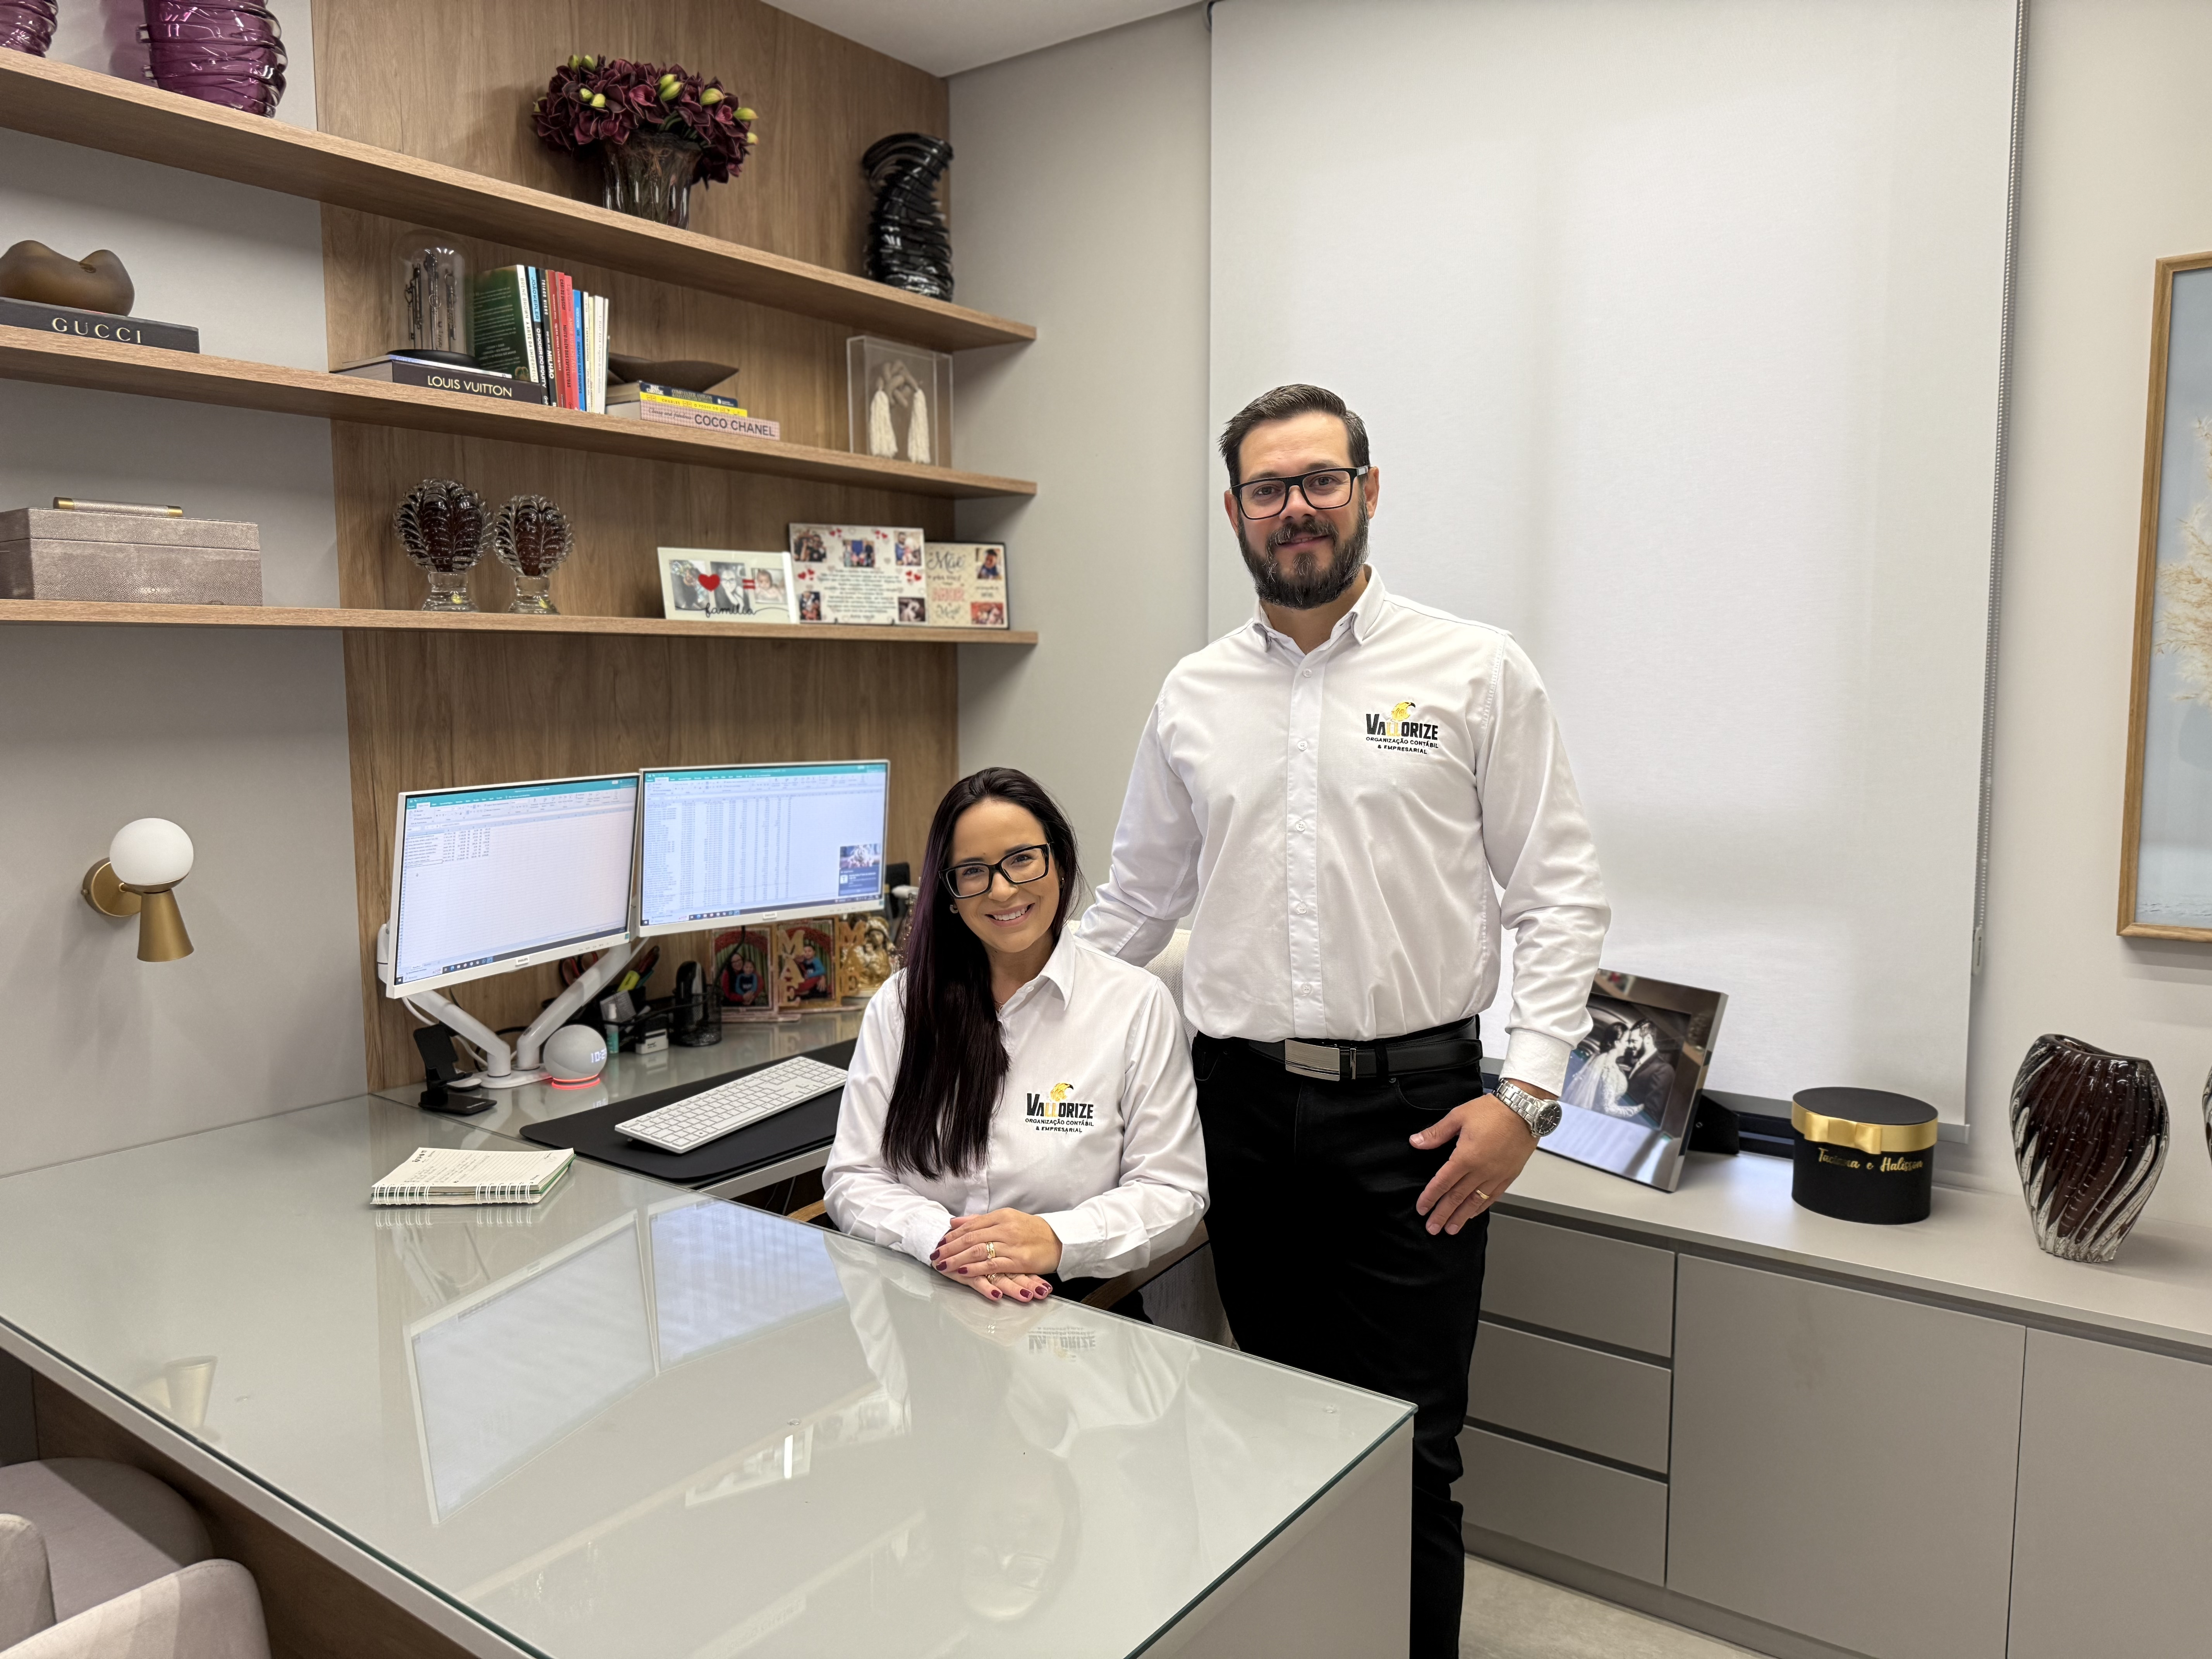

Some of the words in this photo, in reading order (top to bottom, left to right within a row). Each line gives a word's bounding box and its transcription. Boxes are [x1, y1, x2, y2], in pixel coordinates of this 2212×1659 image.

[52, 318, 141, 343] GUCCI
[539, 355, 544, 365] DO
[428, 375, 460, 389] LOUIS
[464, 381, 512, 397] VUITTON
[694, 414, 728, 429] COCO
[731, 420, 775, 437] CHANEL
[1366, 737, 1408, 745] ORGANIZAÇÃO
[1410, 740, 1439, 748] CONTÁBIL
[1384, 745, 1427, 754] EMPRESARIAL
[591, 1048, 606, 1063] 10:2
